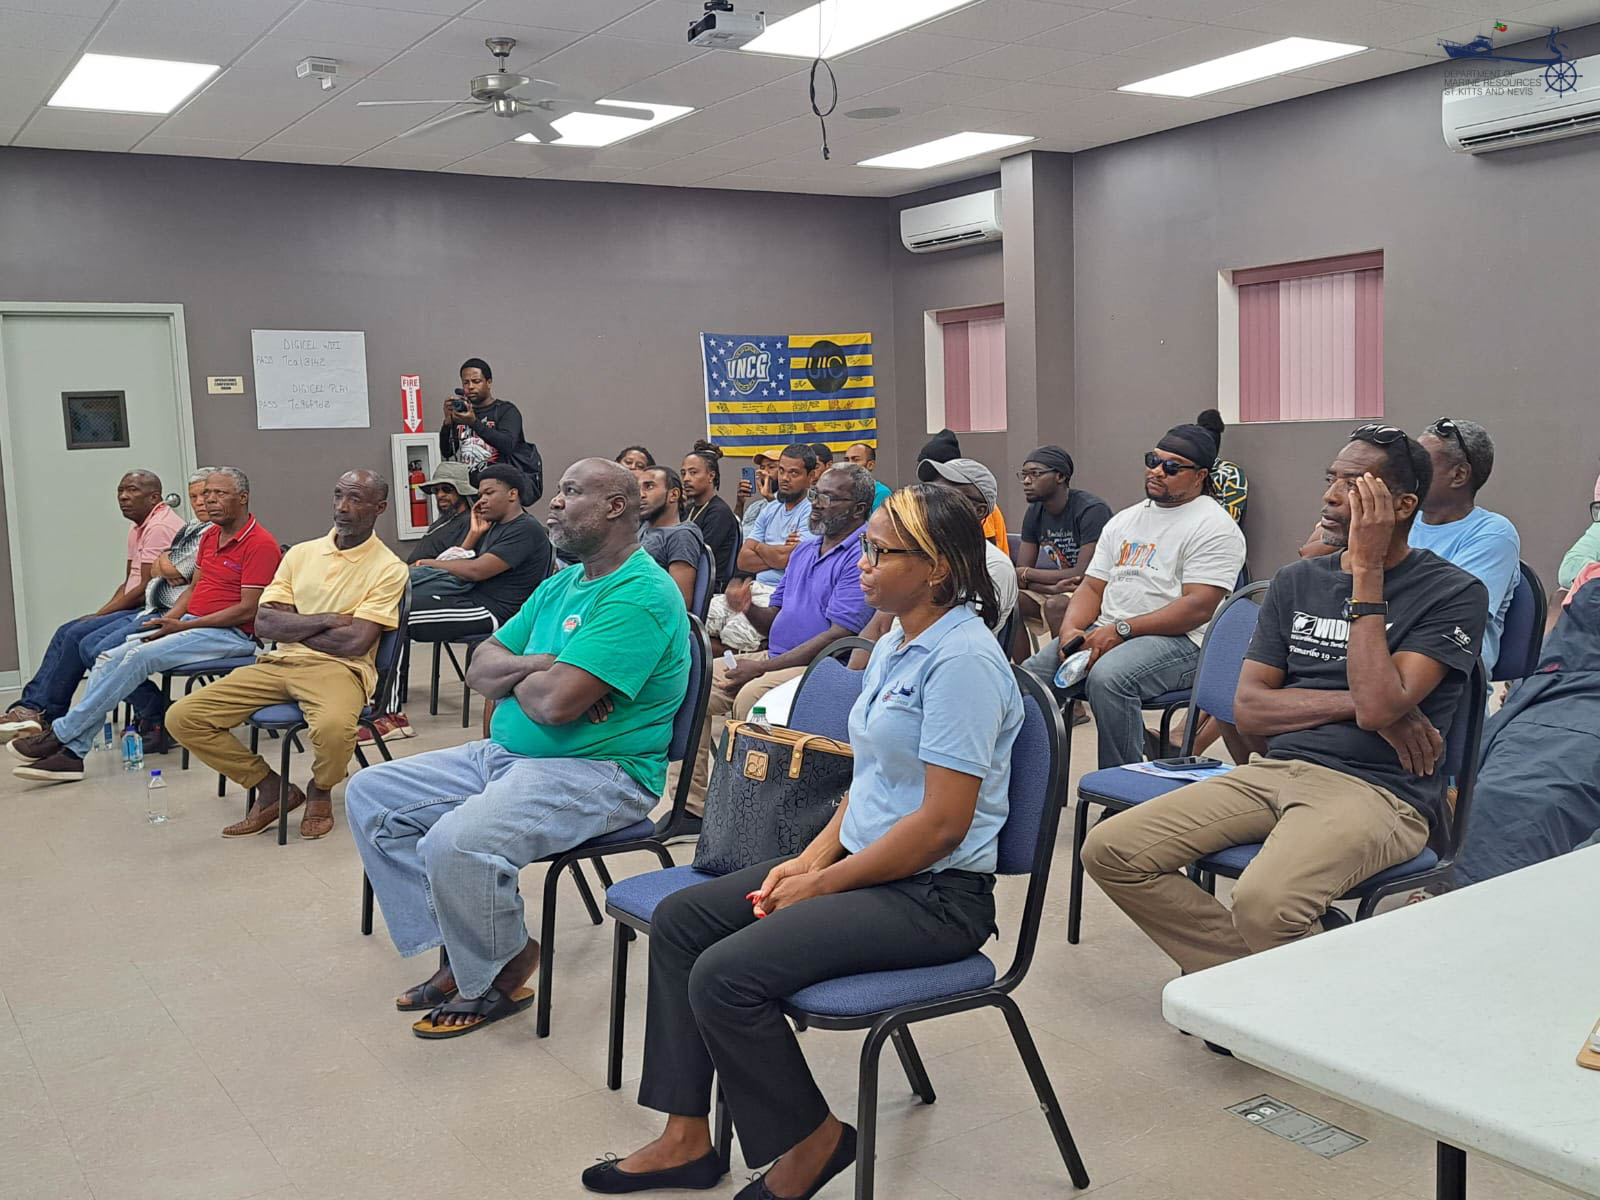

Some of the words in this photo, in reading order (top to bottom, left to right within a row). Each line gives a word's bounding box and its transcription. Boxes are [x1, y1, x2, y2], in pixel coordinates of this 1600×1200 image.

[727, 353, 768, 379] UNCG
[402, 378, 418, 387] FIRE
[1314, 617, 1351, 641] WID
